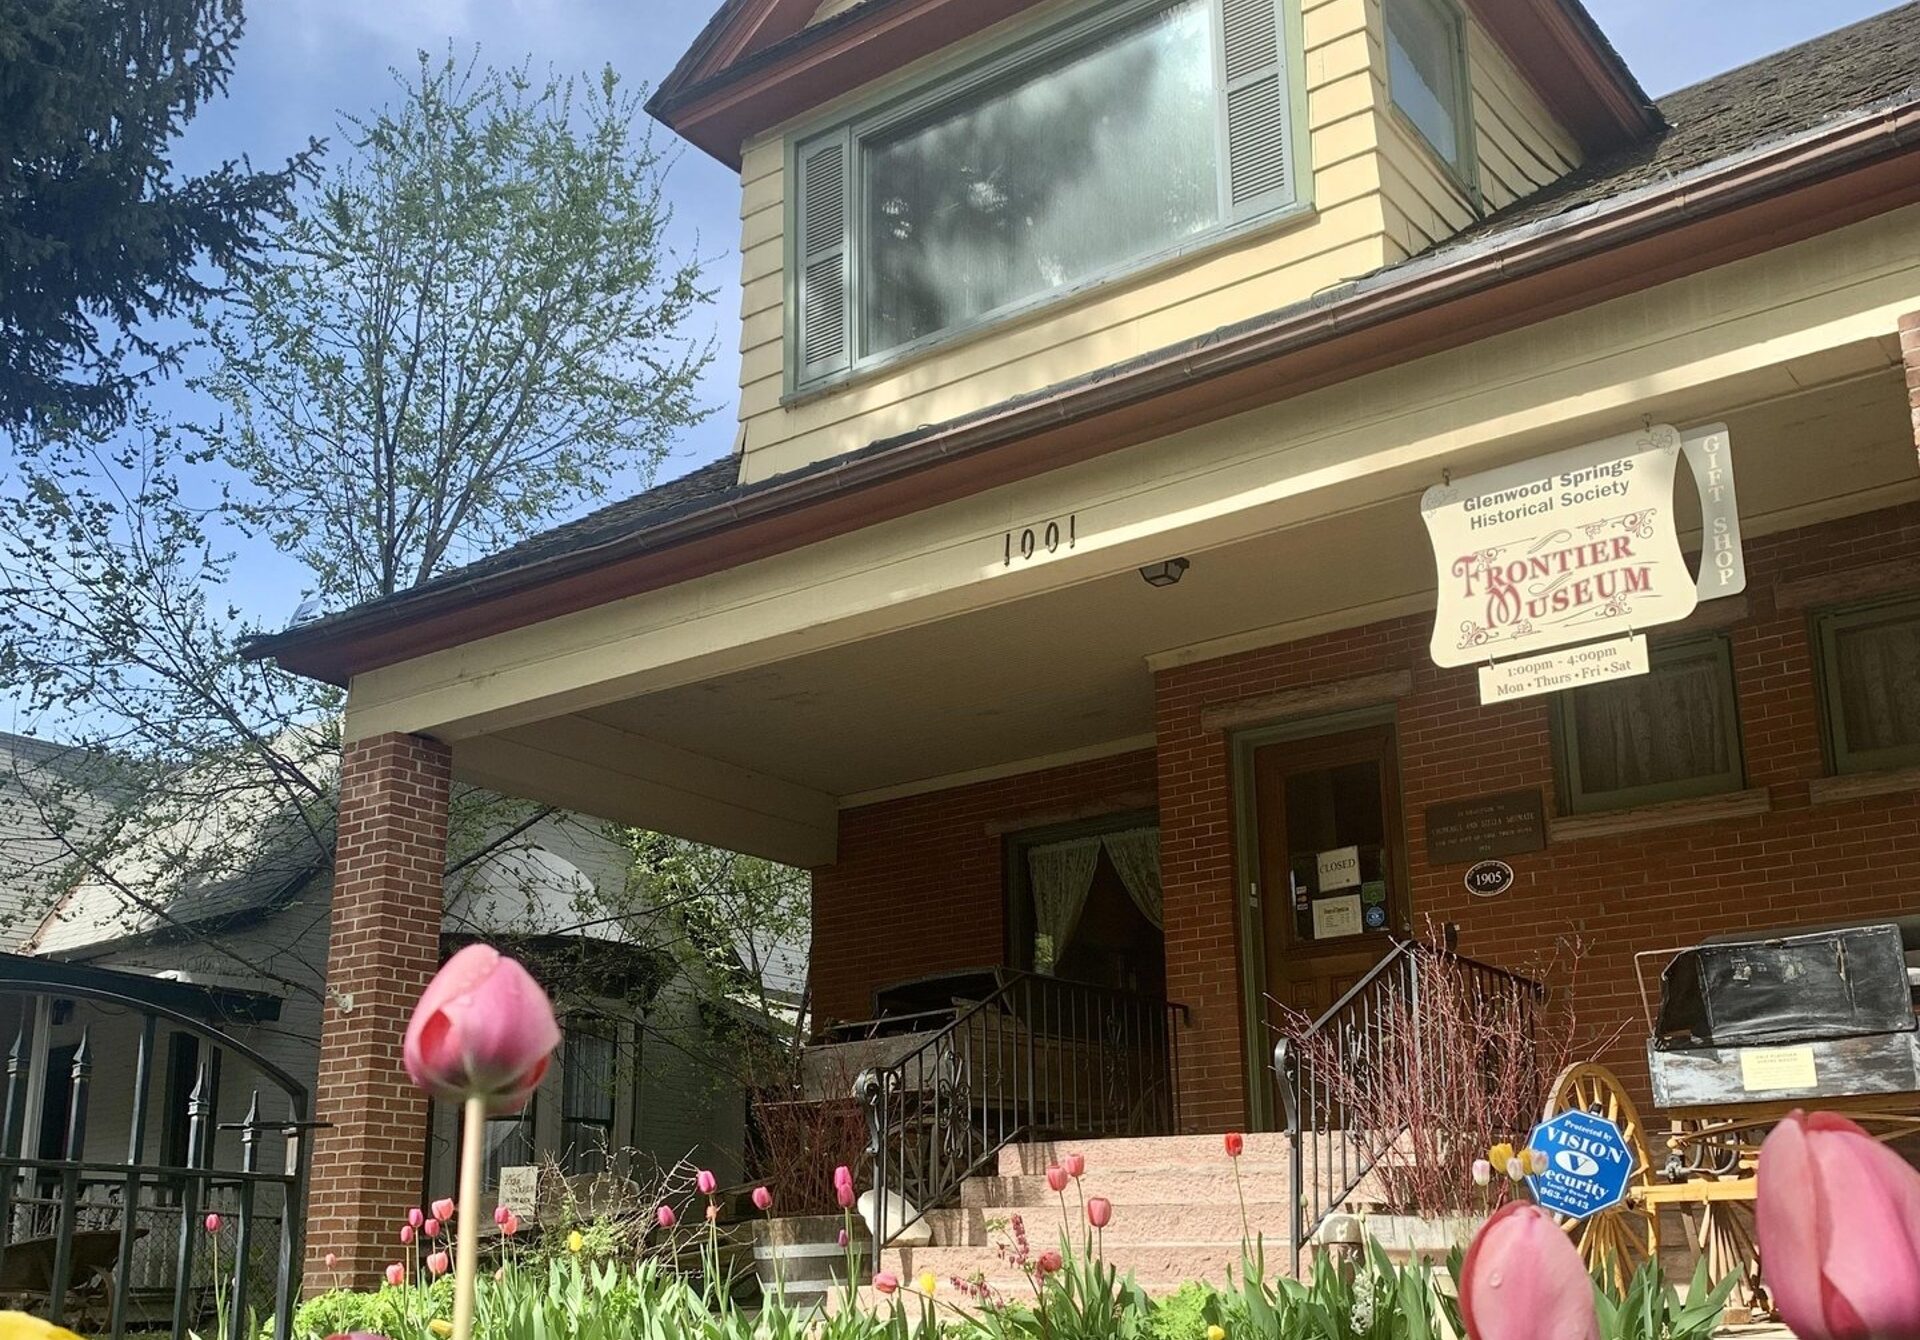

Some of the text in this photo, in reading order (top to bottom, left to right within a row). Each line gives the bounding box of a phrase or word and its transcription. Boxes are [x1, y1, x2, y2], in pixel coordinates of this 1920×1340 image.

[1464, 459, 1633, 511] Glenwood Springs
[1703, 436, 1724, 501] GIFT
[1471, 480, 1629, 530] Historical Society
[1004, 515, 1075, 567] 1001
[1713, 517, 1734, 585] SHOP
[1452, 536, 1635, 598] FRONTIER
[1486, 567, 1653, 629] MUSEUM
[1497, 660, 1632, 696] Mon Thurs Fri Sat
[1508, 660, 1553, 677] 1:00pm
[1567, 647, 1617, 666] 4:00pm
[1320, 858, 1355, 874] CLOSED
[1475, 871, 1502, 885] 1905
[1548, 1126, 1624, 1164] VISION
[1564, 1119, 1613, 1142] Protected by
[1542, 1170, 1609, 1200] ecurity
